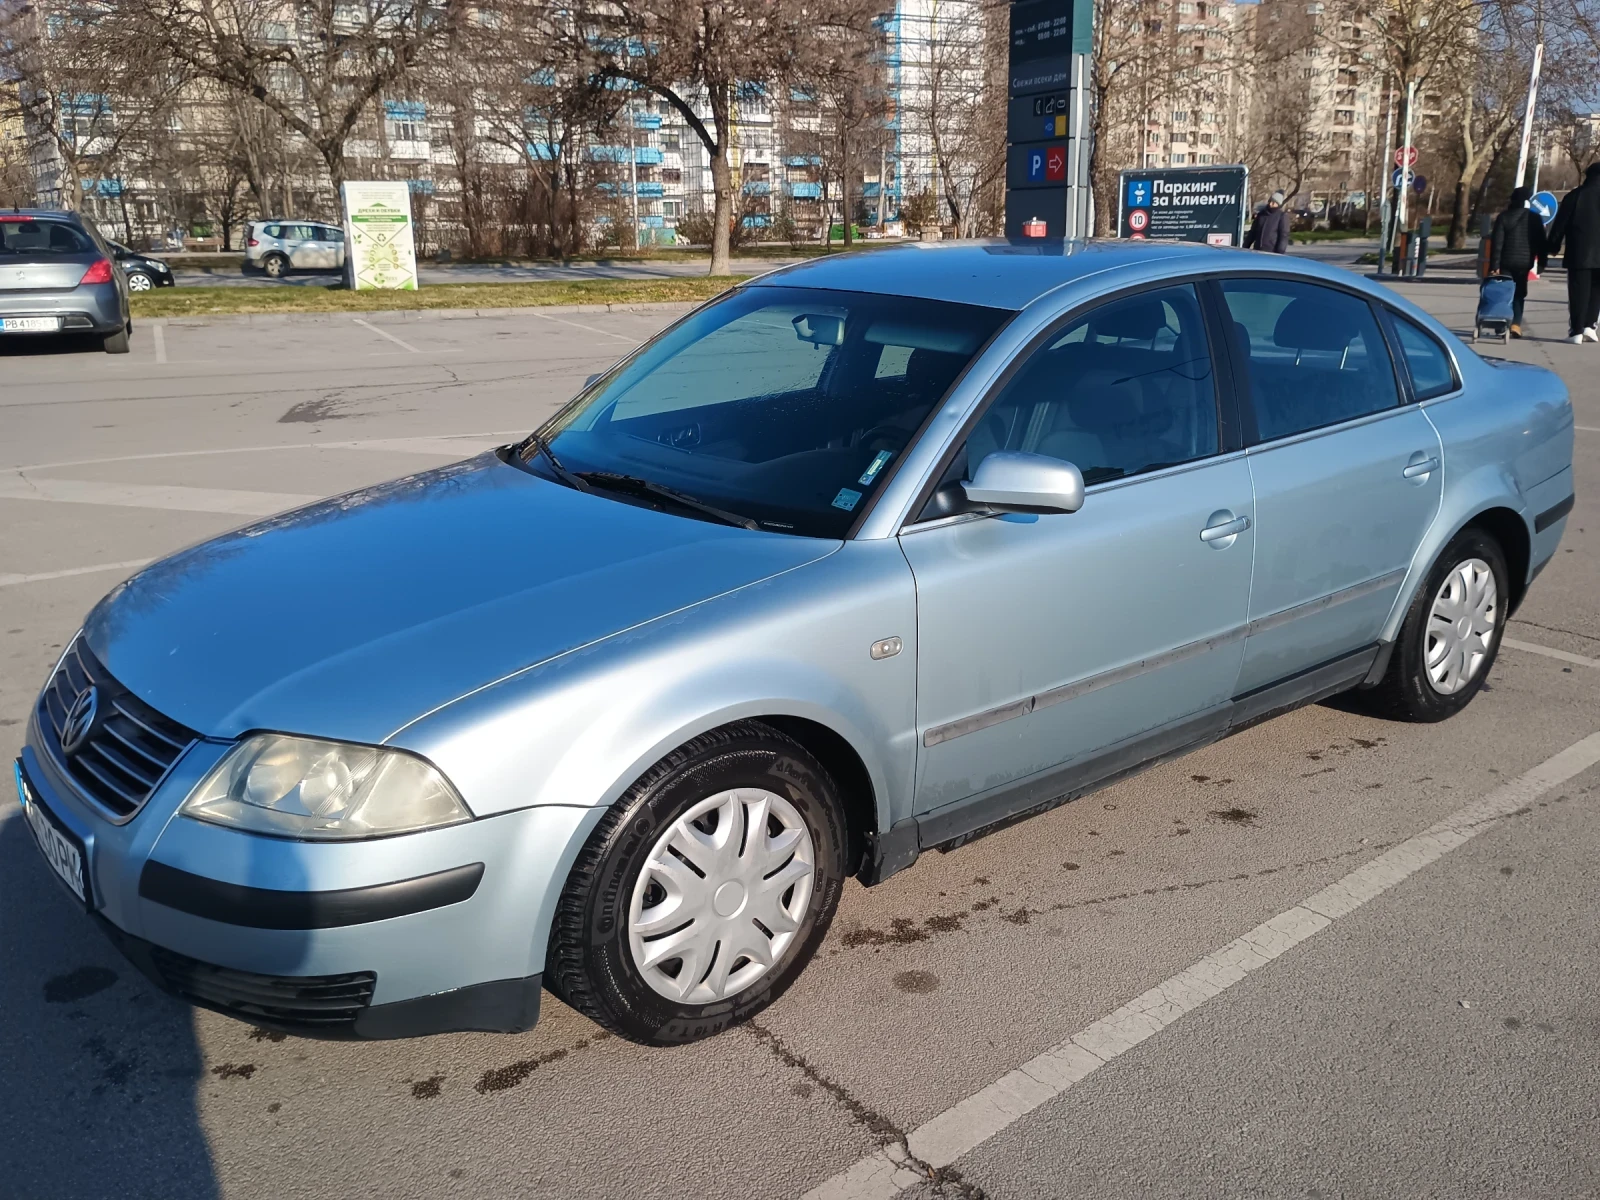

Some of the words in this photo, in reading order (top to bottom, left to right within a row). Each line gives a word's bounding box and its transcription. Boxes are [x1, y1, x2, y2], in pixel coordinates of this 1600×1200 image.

[1032, 155, 1042, 176] P
[1153, 180, 1217, 196] Паркинг
[1152, 196, 1169, 206] за
[1173, 194, 1236, 206] клиенти
[1134, 215, 1143, 225] 10
